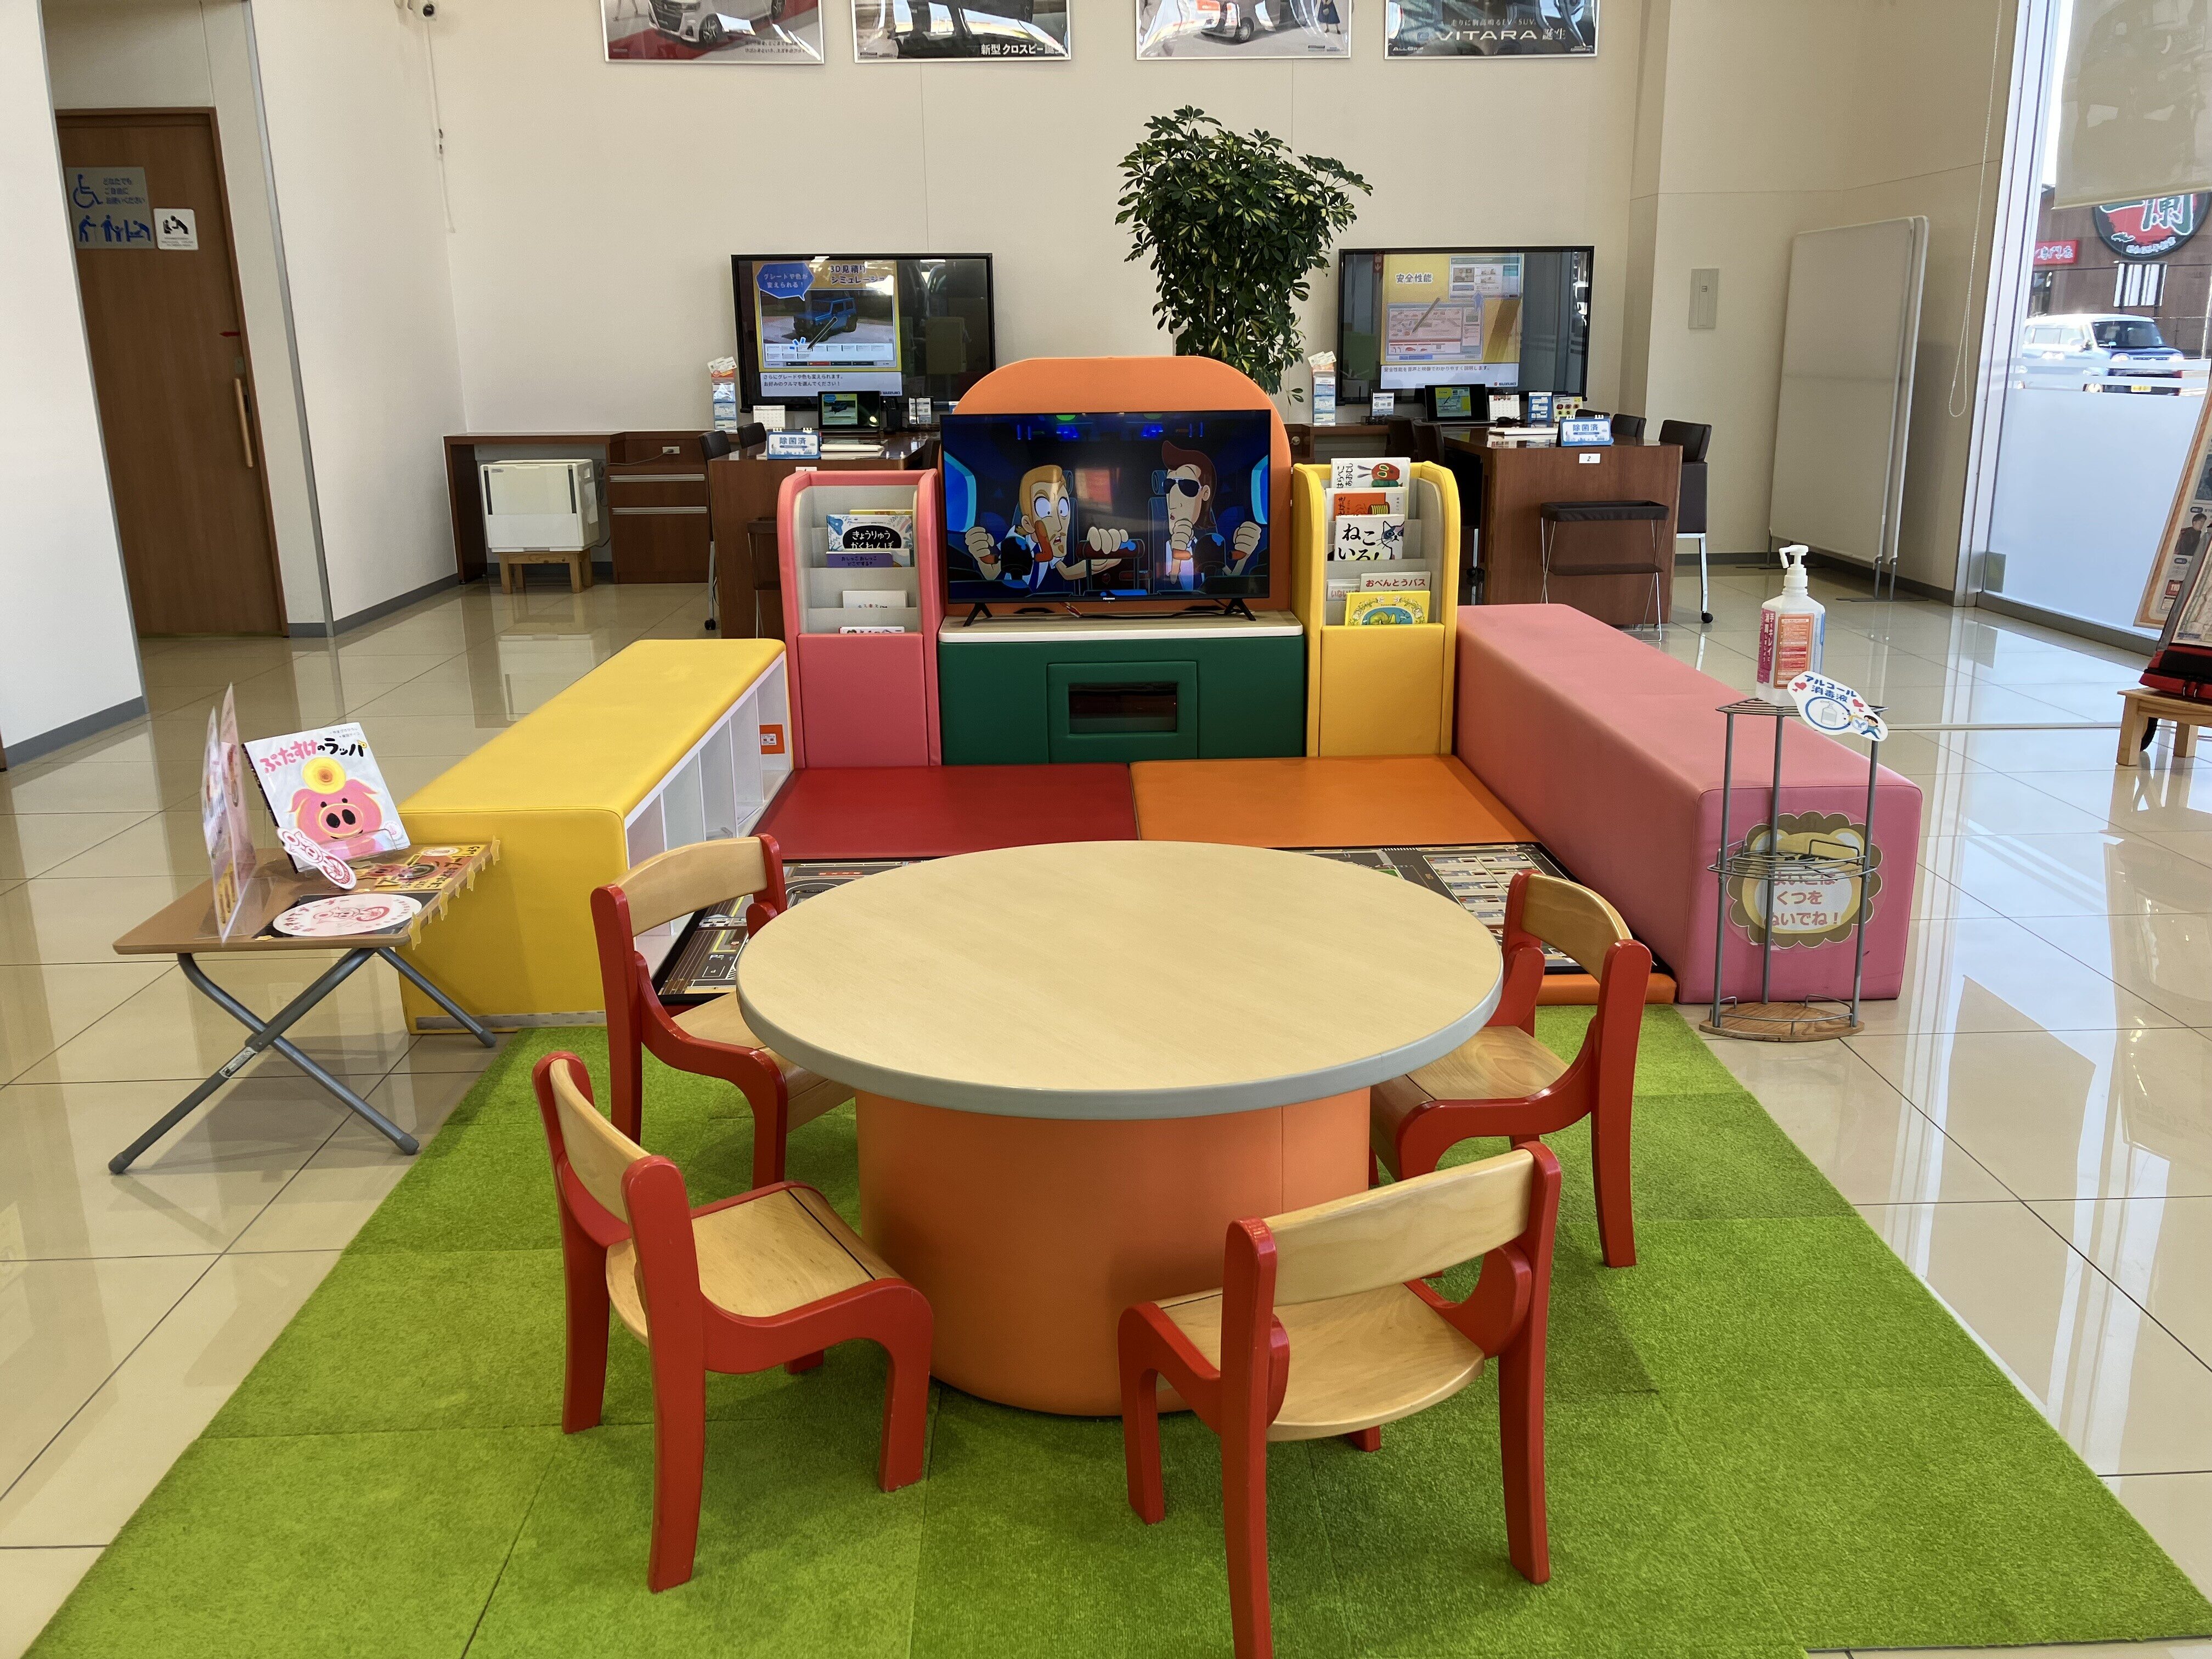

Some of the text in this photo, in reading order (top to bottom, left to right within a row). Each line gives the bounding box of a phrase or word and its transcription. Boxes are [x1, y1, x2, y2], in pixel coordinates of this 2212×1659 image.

[1435, 30, 1537, 41] VITARA
[1396, 273, 1432, 284] 安全性能
[1572, 424, 1599, 432] 除菌済
[779, 437, 806, 445] 除菌済
[1345, 462, 1353, 487] あおむし
[852, 530, 890, 540] きょうりゅう
[1342, 523, 1376, 546] ねこ
[1804, 674, 1857, 697] アルコール
[1811, 685, 1848, 703] 消毒液
[1776, 890, 1822, 906] くつを
